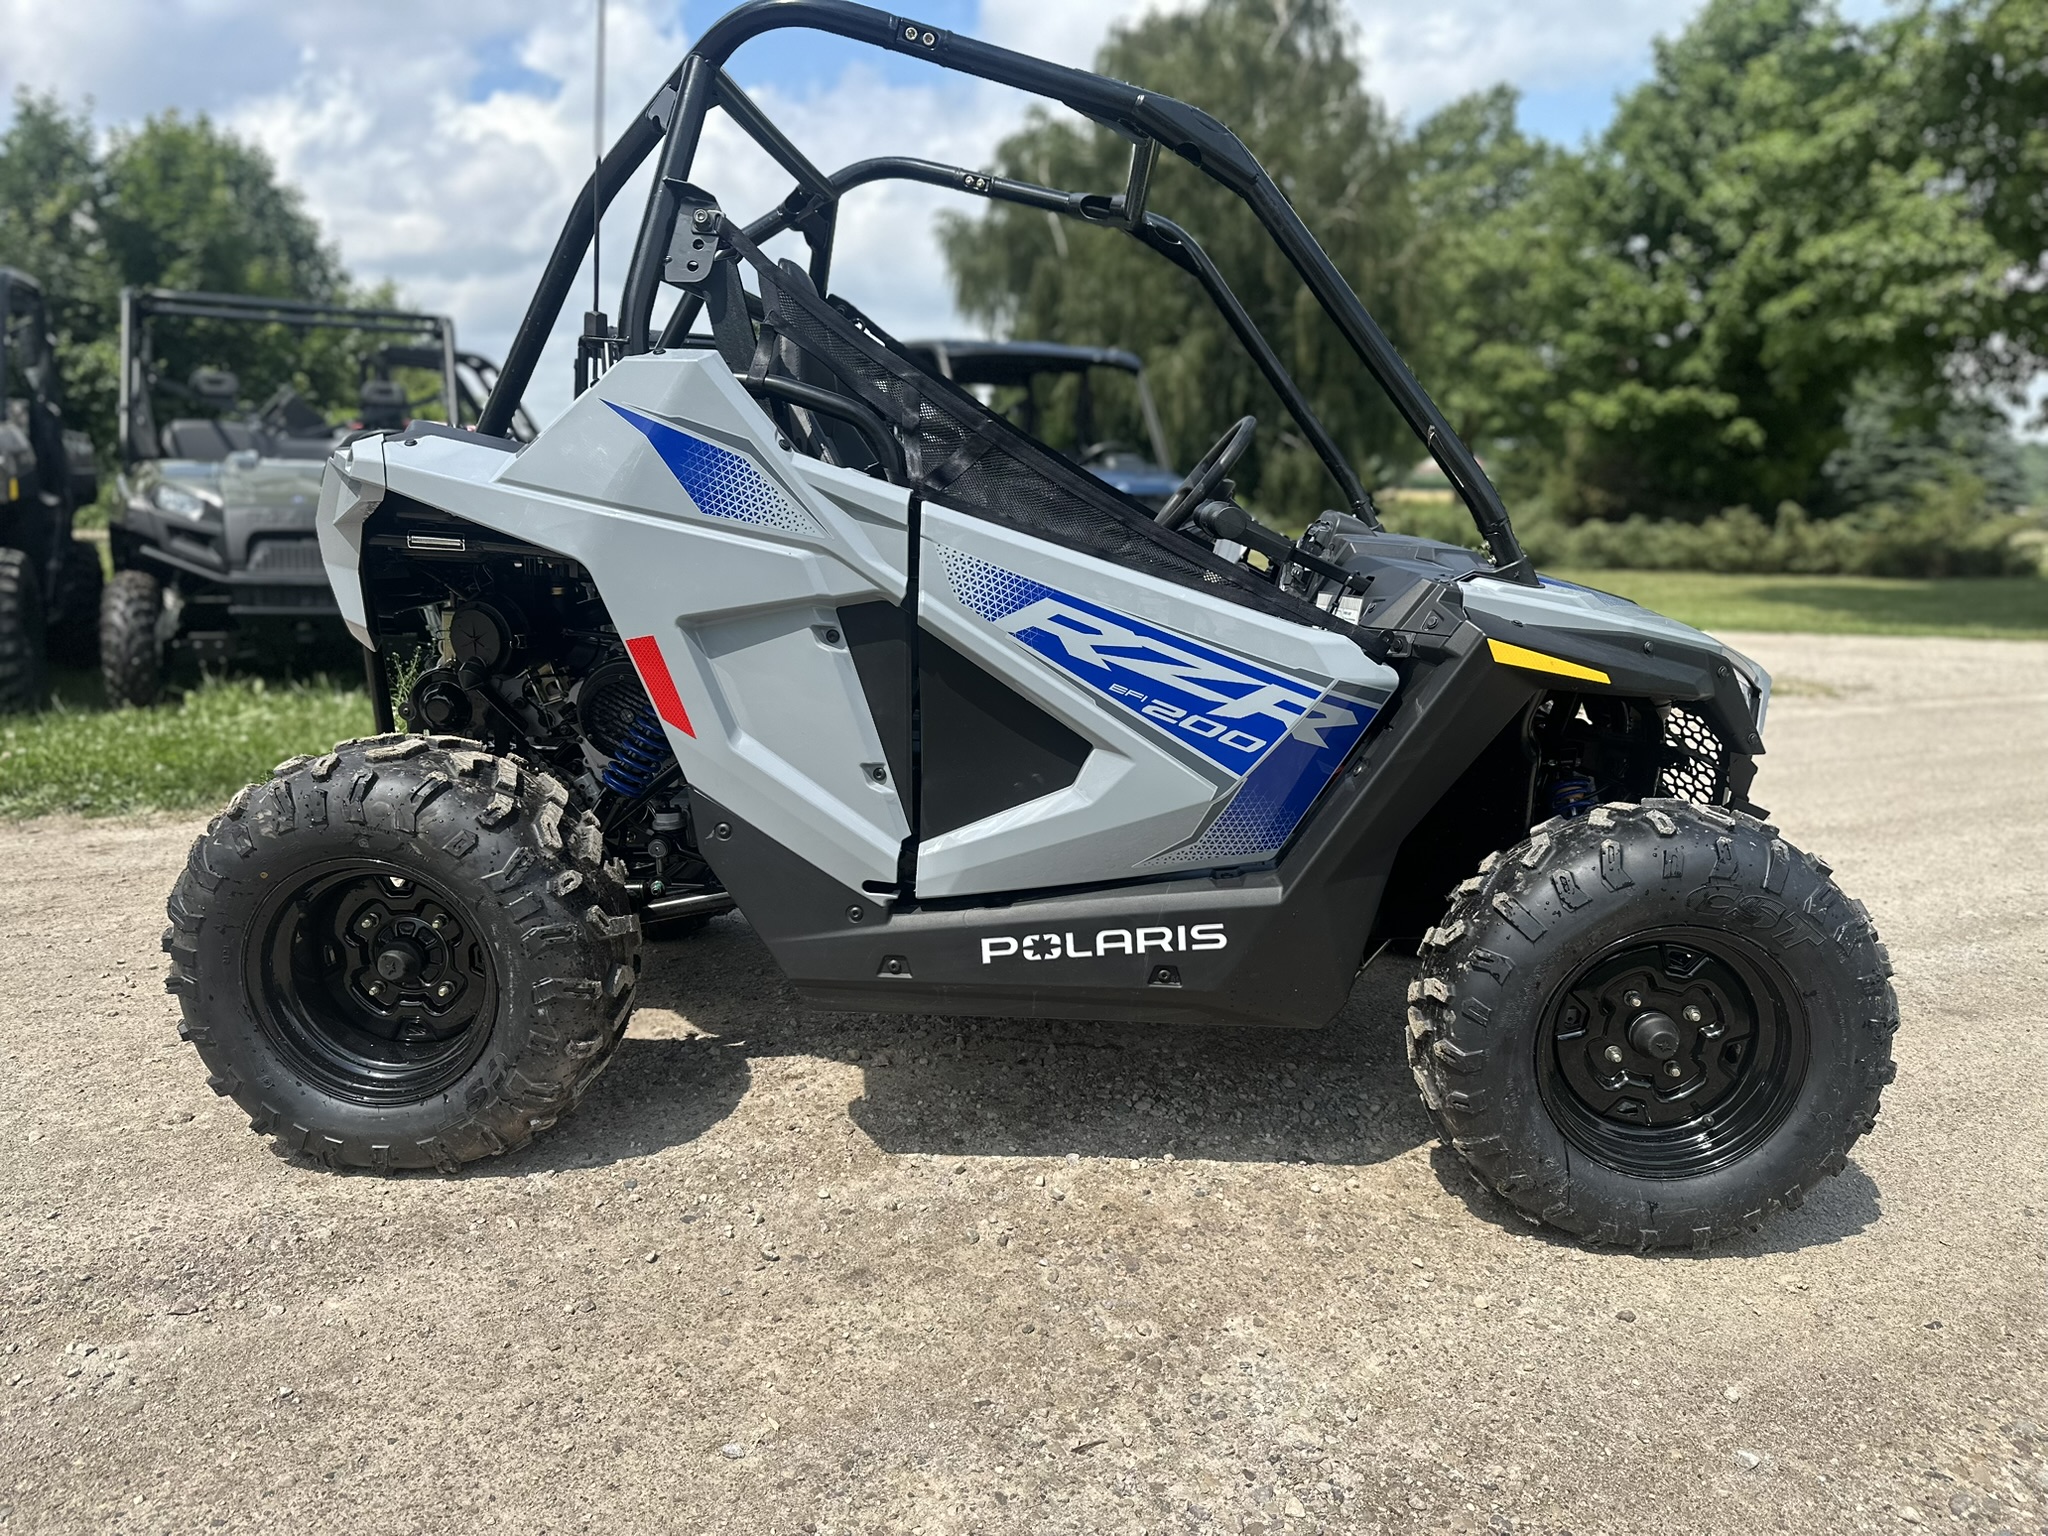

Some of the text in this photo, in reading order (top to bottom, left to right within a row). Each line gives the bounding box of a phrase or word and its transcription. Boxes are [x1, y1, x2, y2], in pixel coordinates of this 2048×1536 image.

[993, 597, 1360, 748] RZR
[1108, 683, 1267, 753] EFI 200
[981, 923, 1228, 964] POLARIS
